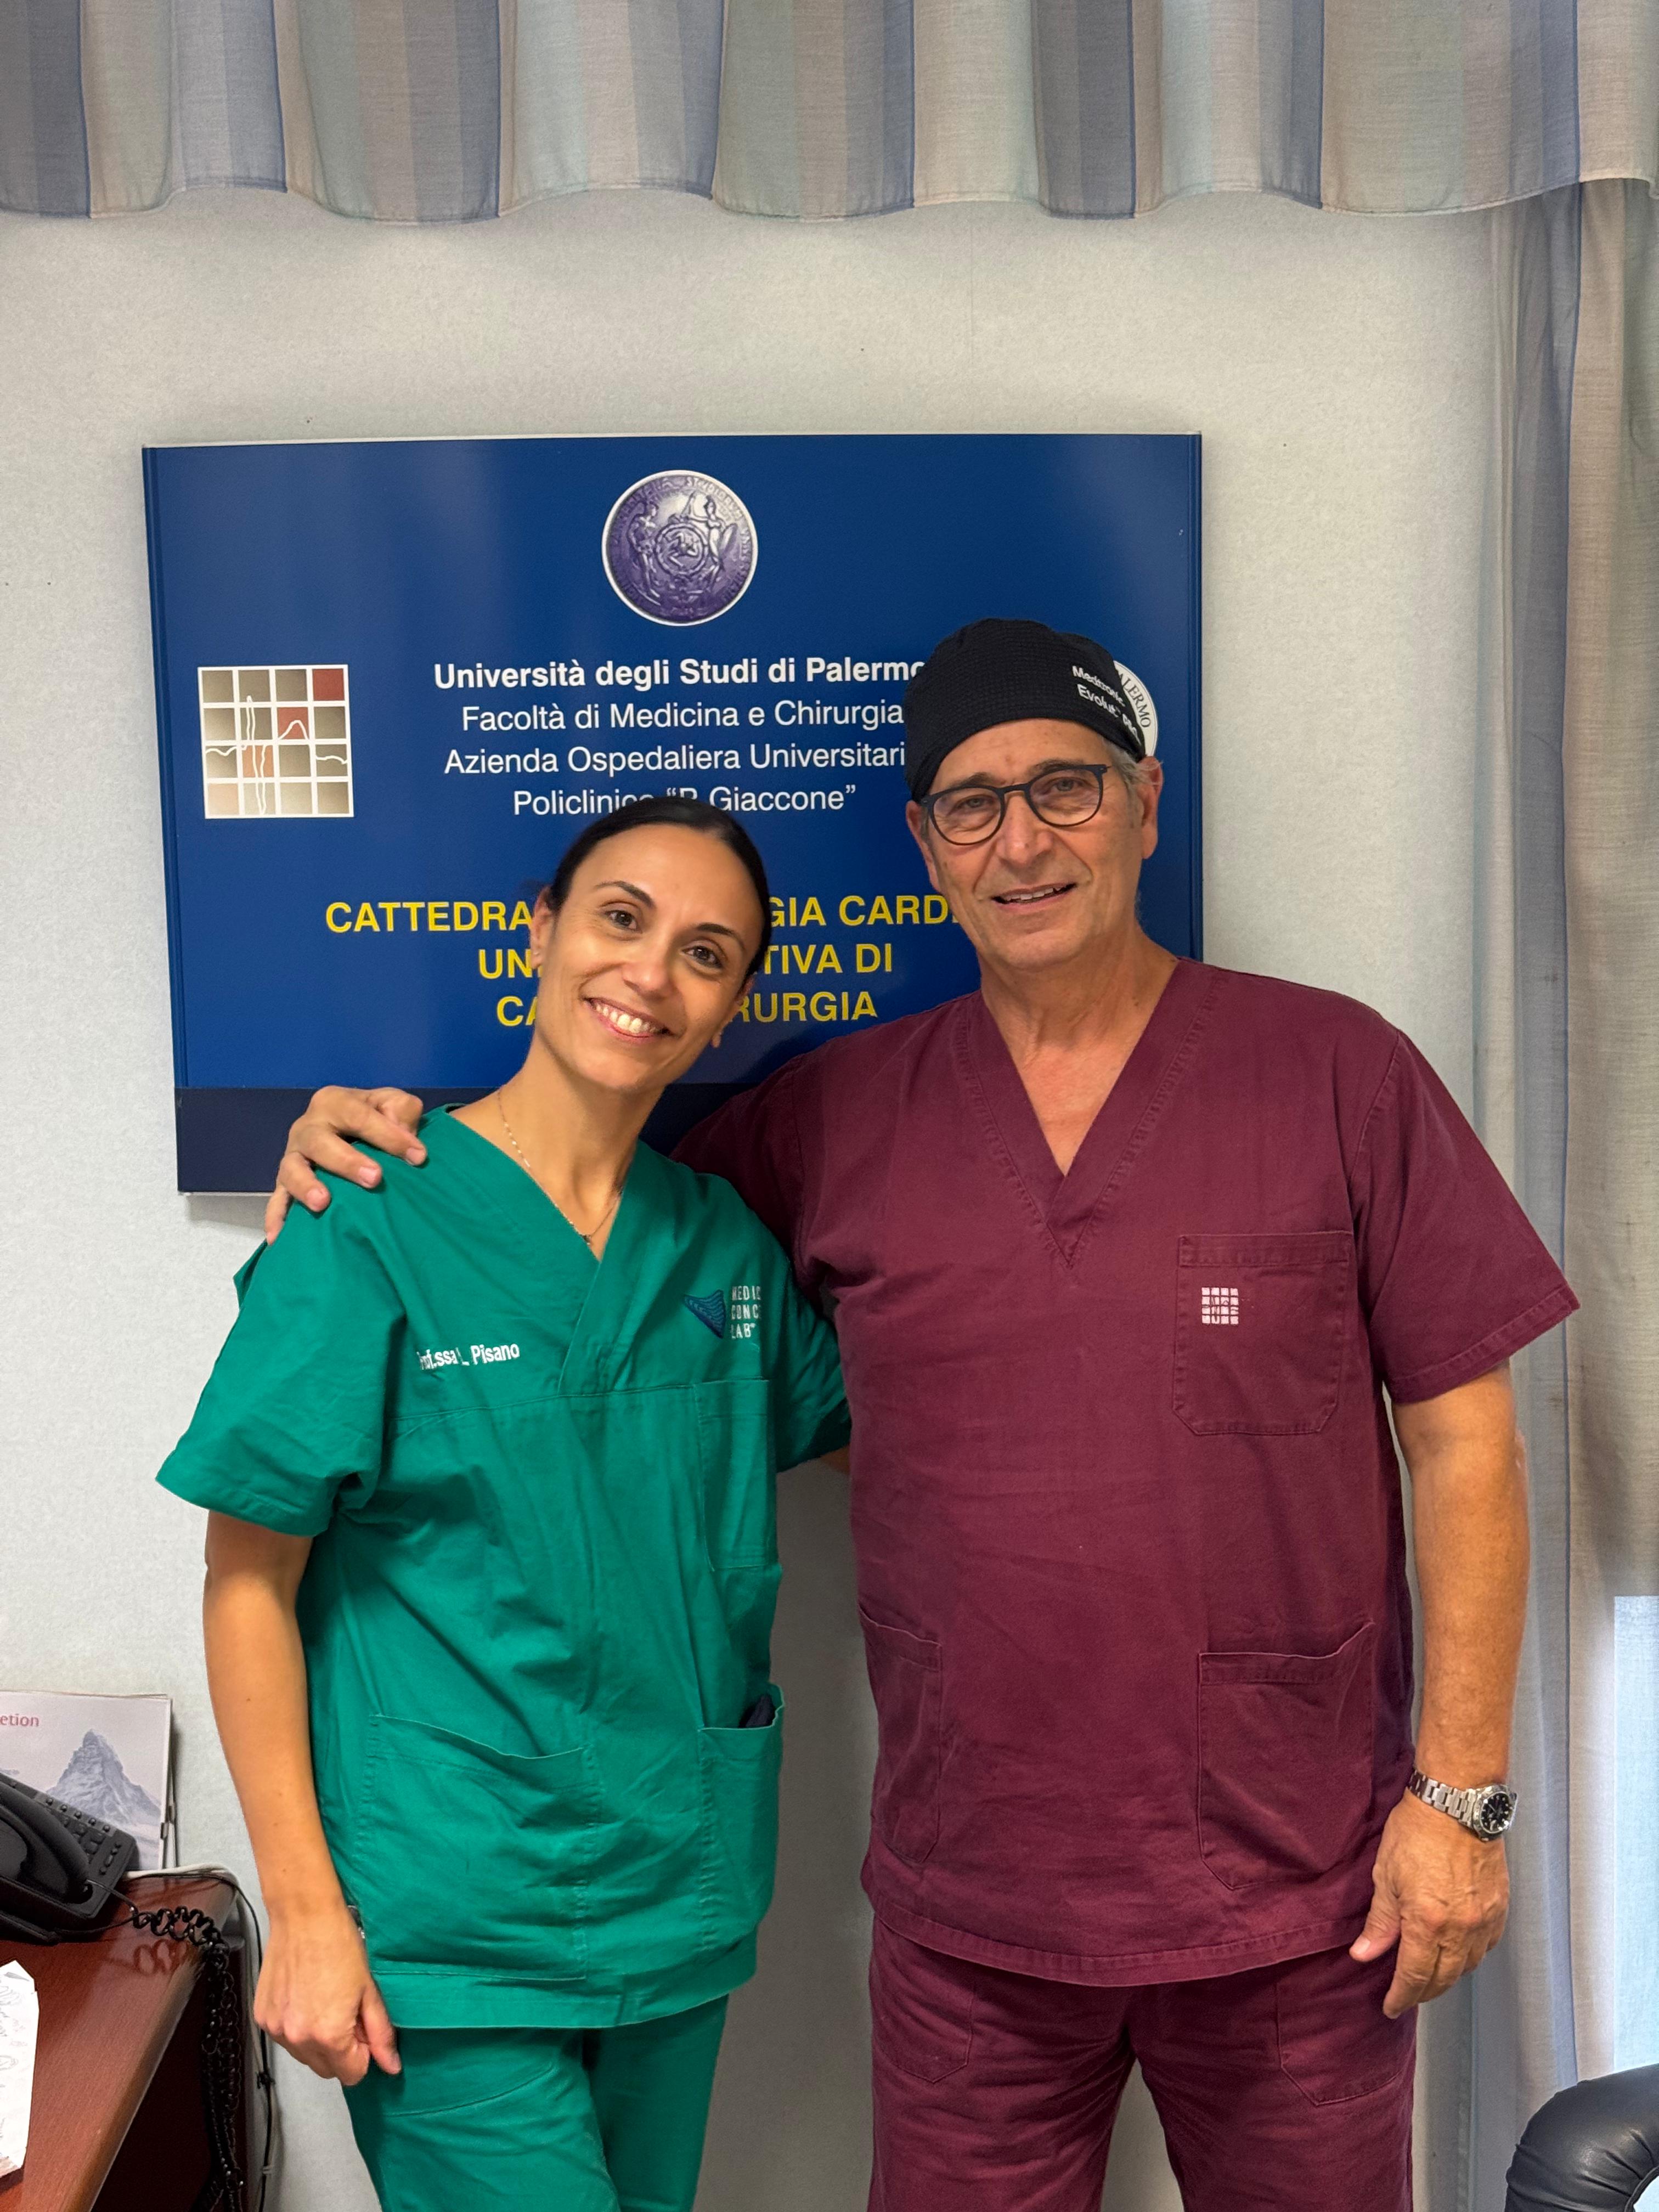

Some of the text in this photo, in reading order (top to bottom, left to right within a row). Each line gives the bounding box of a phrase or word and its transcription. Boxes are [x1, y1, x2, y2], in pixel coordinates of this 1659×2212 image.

[434, 659, 586, 689] Università
[595, 659, 669, 692] degli
[680, 658, 758, 684] Studi
[768, 658, 795, 682] di
[462, 699, 904, 731] Facoltà di Medicina e Chirurgia
[444, 741, 905, 777] Azienda Ospedaliera Universitari
[514, 788, 654, 815] Policlinic
[326, 901, 532, 933] CATTEDRA
[839, 895, 958, 926] CARD
[856, 943, 892, 973] DI
[470, 1344, 520, 1365] Pisano
[0, 1713, 40, 1727] etion
